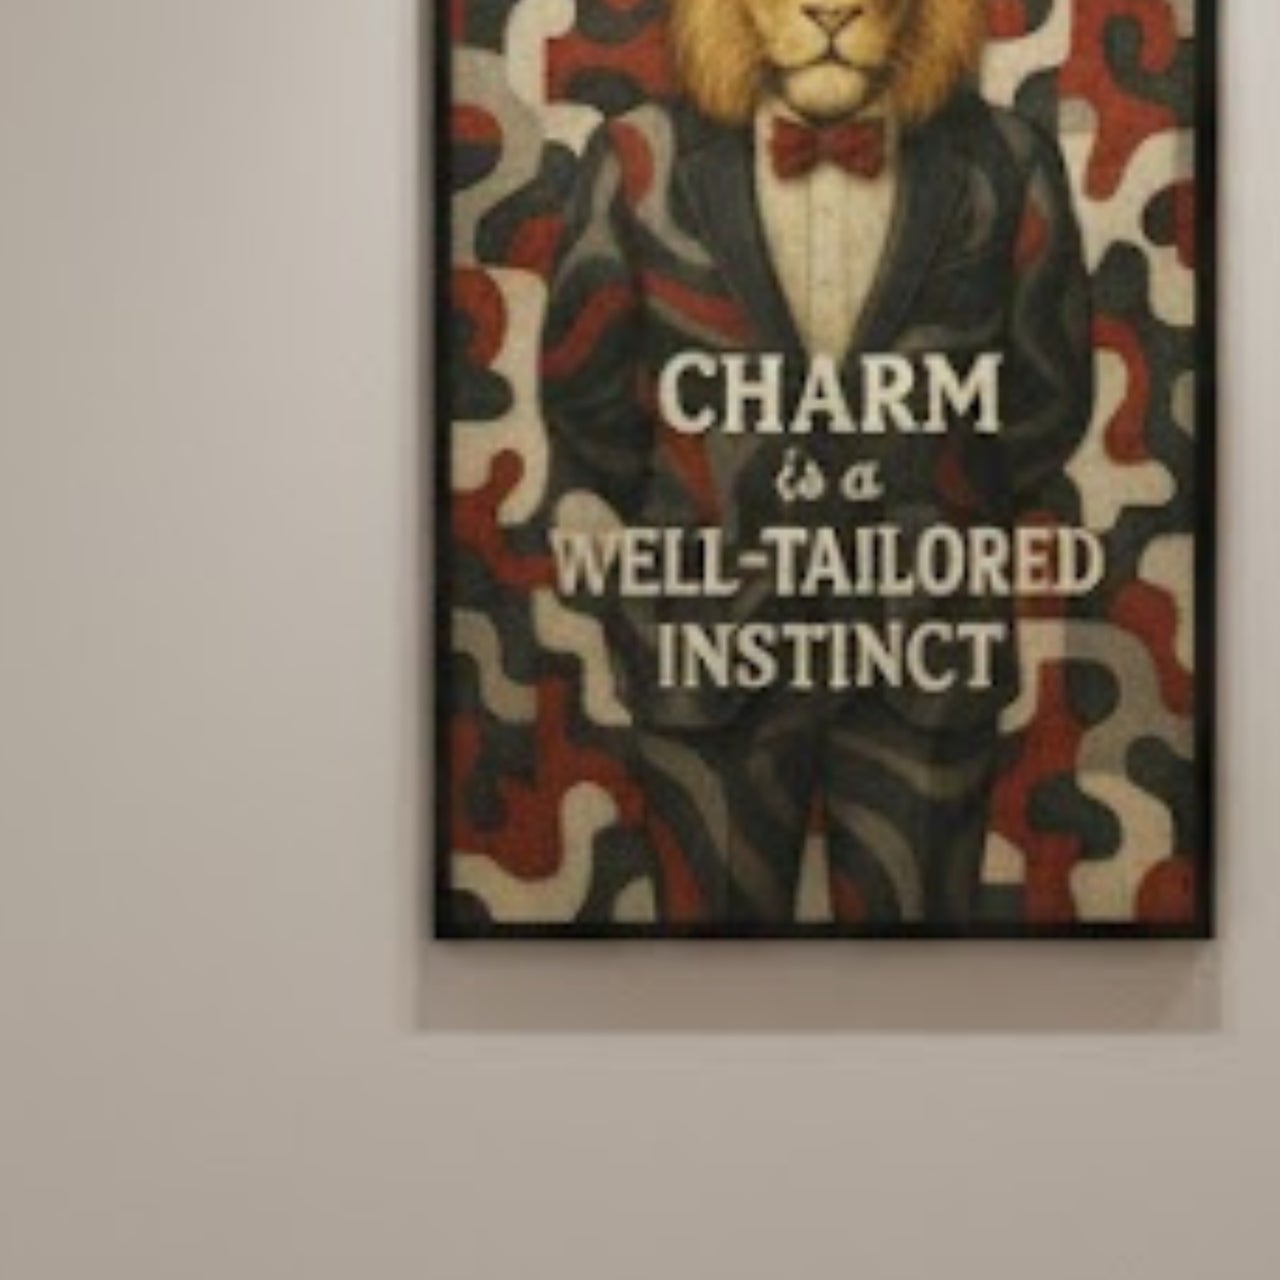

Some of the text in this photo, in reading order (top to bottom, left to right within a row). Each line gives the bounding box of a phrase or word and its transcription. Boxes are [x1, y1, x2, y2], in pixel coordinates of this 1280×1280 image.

[658, 353, 1003, 434] CHARM
[775, 449, 884, 502] is a
[551, 526, 1105, 598] WELL-TAILORED
[658, 623, 1006, 691] INSTINCT
